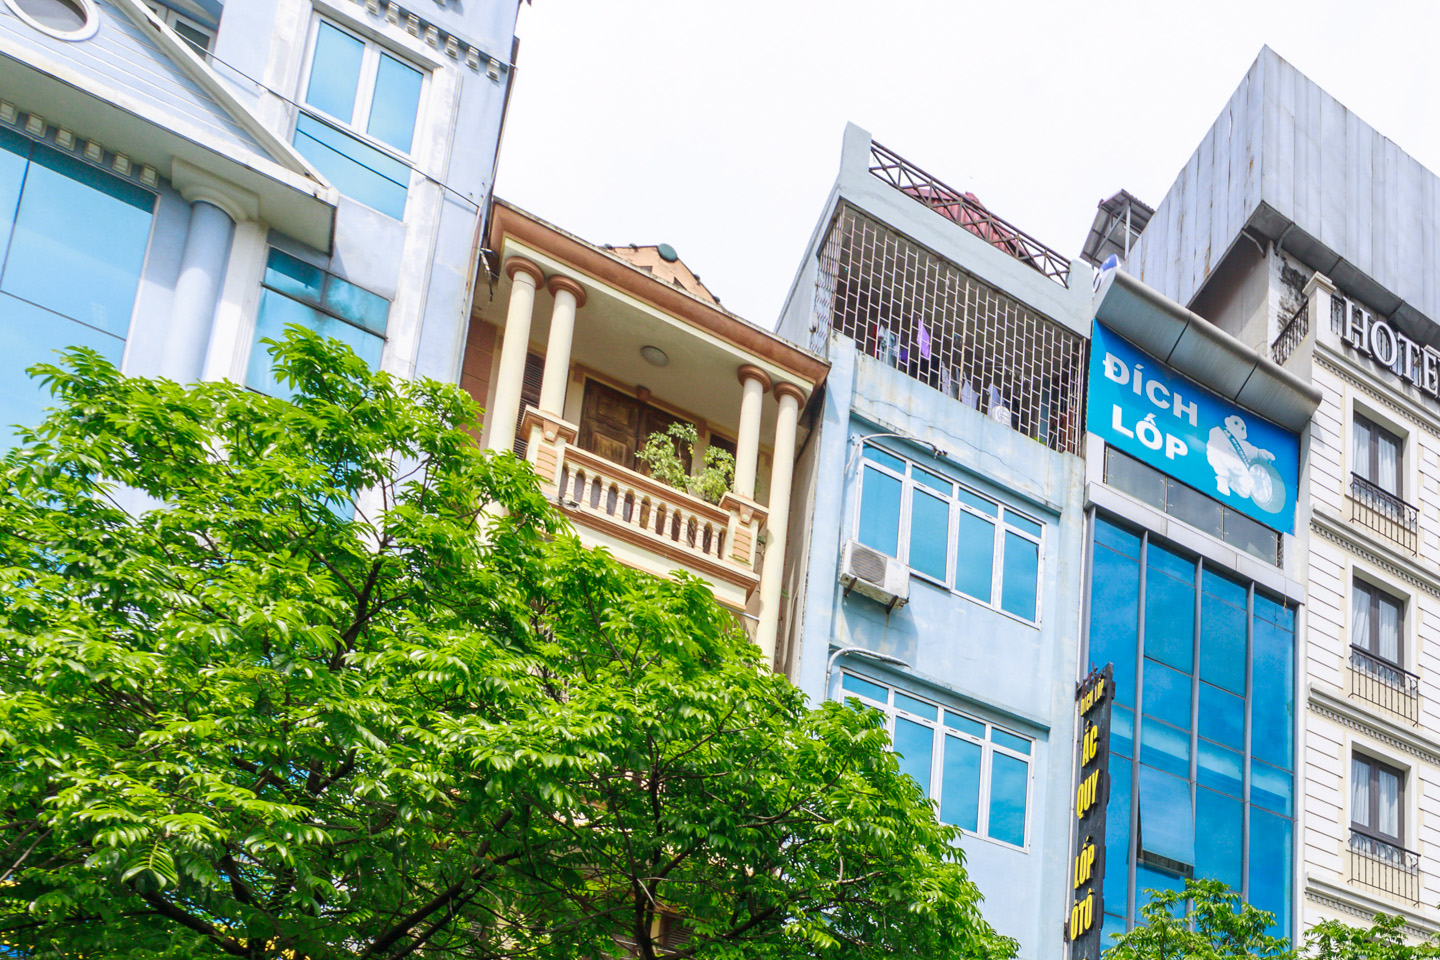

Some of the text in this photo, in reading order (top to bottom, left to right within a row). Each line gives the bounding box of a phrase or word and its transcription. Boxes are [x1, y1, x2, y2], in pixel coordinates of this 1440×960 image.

[1103, 351, 1197, 427] ĐÍCH
[1112, 404, 1188, 460] LỐP
[1076, 769, 1100, 819] QUY
[1074, 836, 1096, 890] LỐP
[1070, 888, 1094, 941] ÔTÔ
